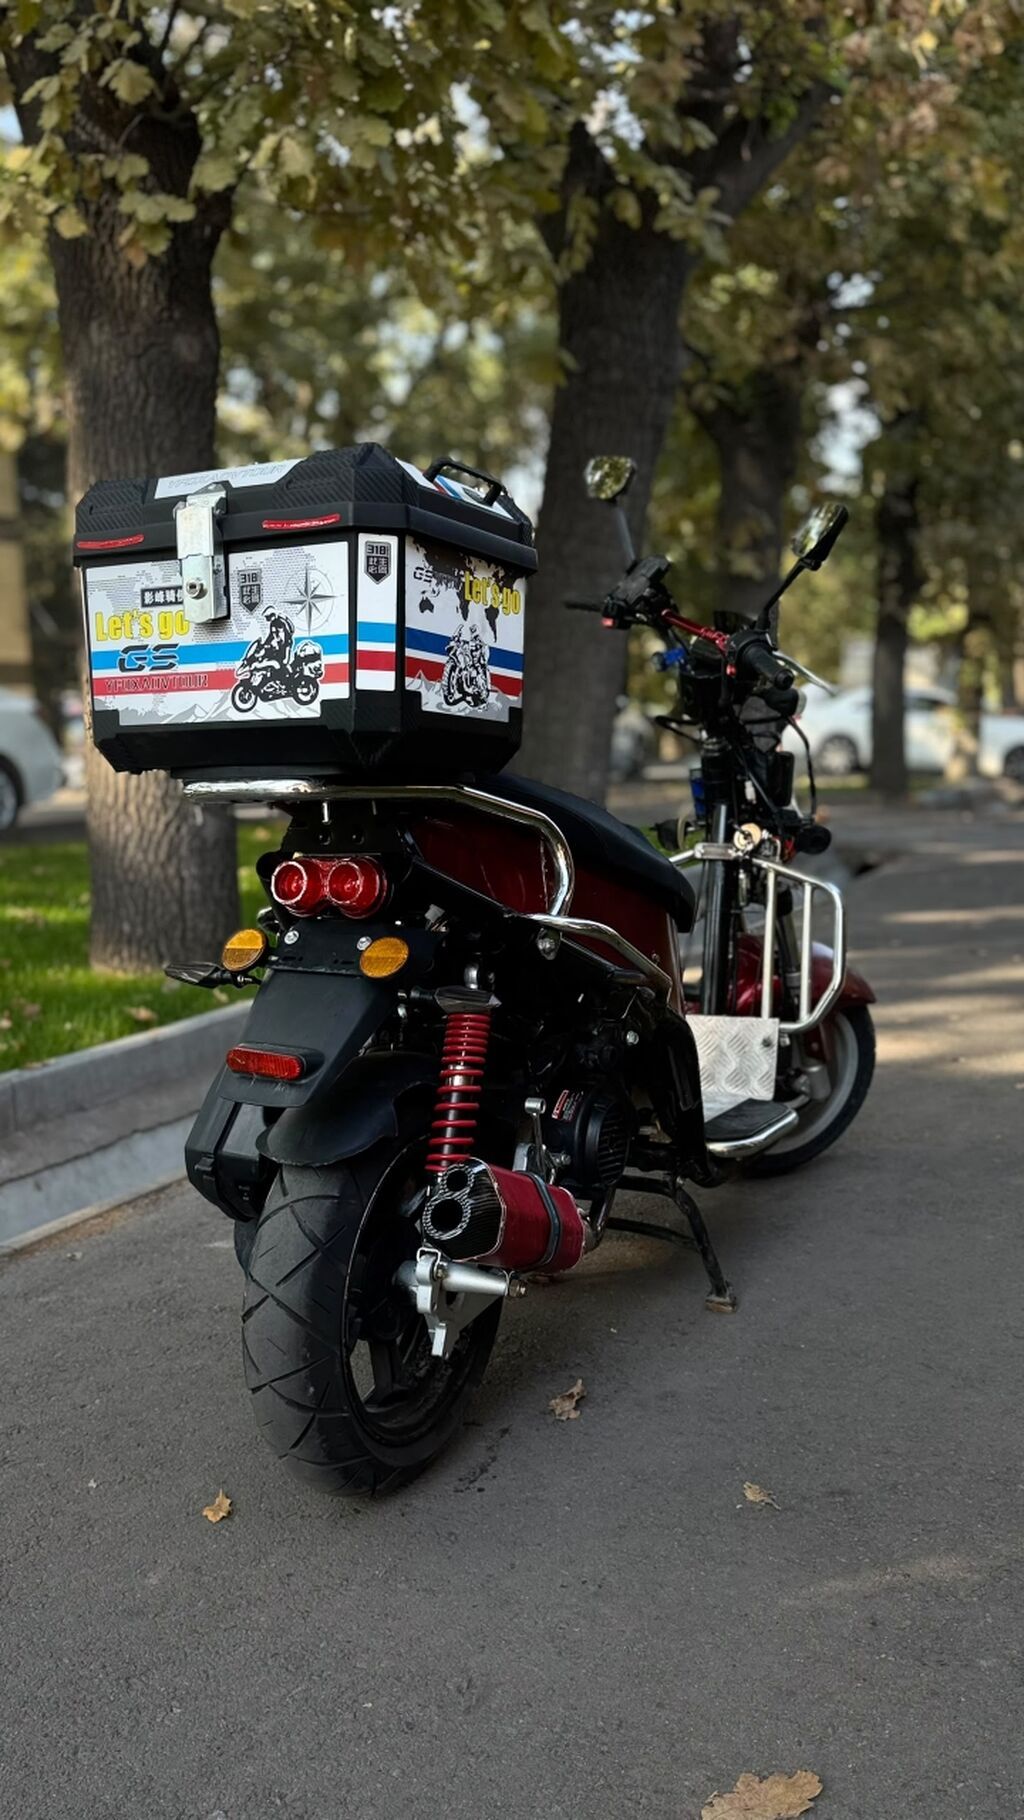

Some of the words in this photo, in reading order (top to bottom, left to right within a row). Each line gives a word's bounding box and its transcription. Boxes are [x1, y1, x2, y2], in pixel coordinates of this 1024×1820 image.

[367, 544, 386, 555] 318
[239, 572, 258, 584] 318
[413, 566, 433, 583] GS
[464, 571, 500, 608] Let's
[502, 587, 521, 616] go
[96, 609, 153, 641] Let's
[118, 643, 179, 672] GS
